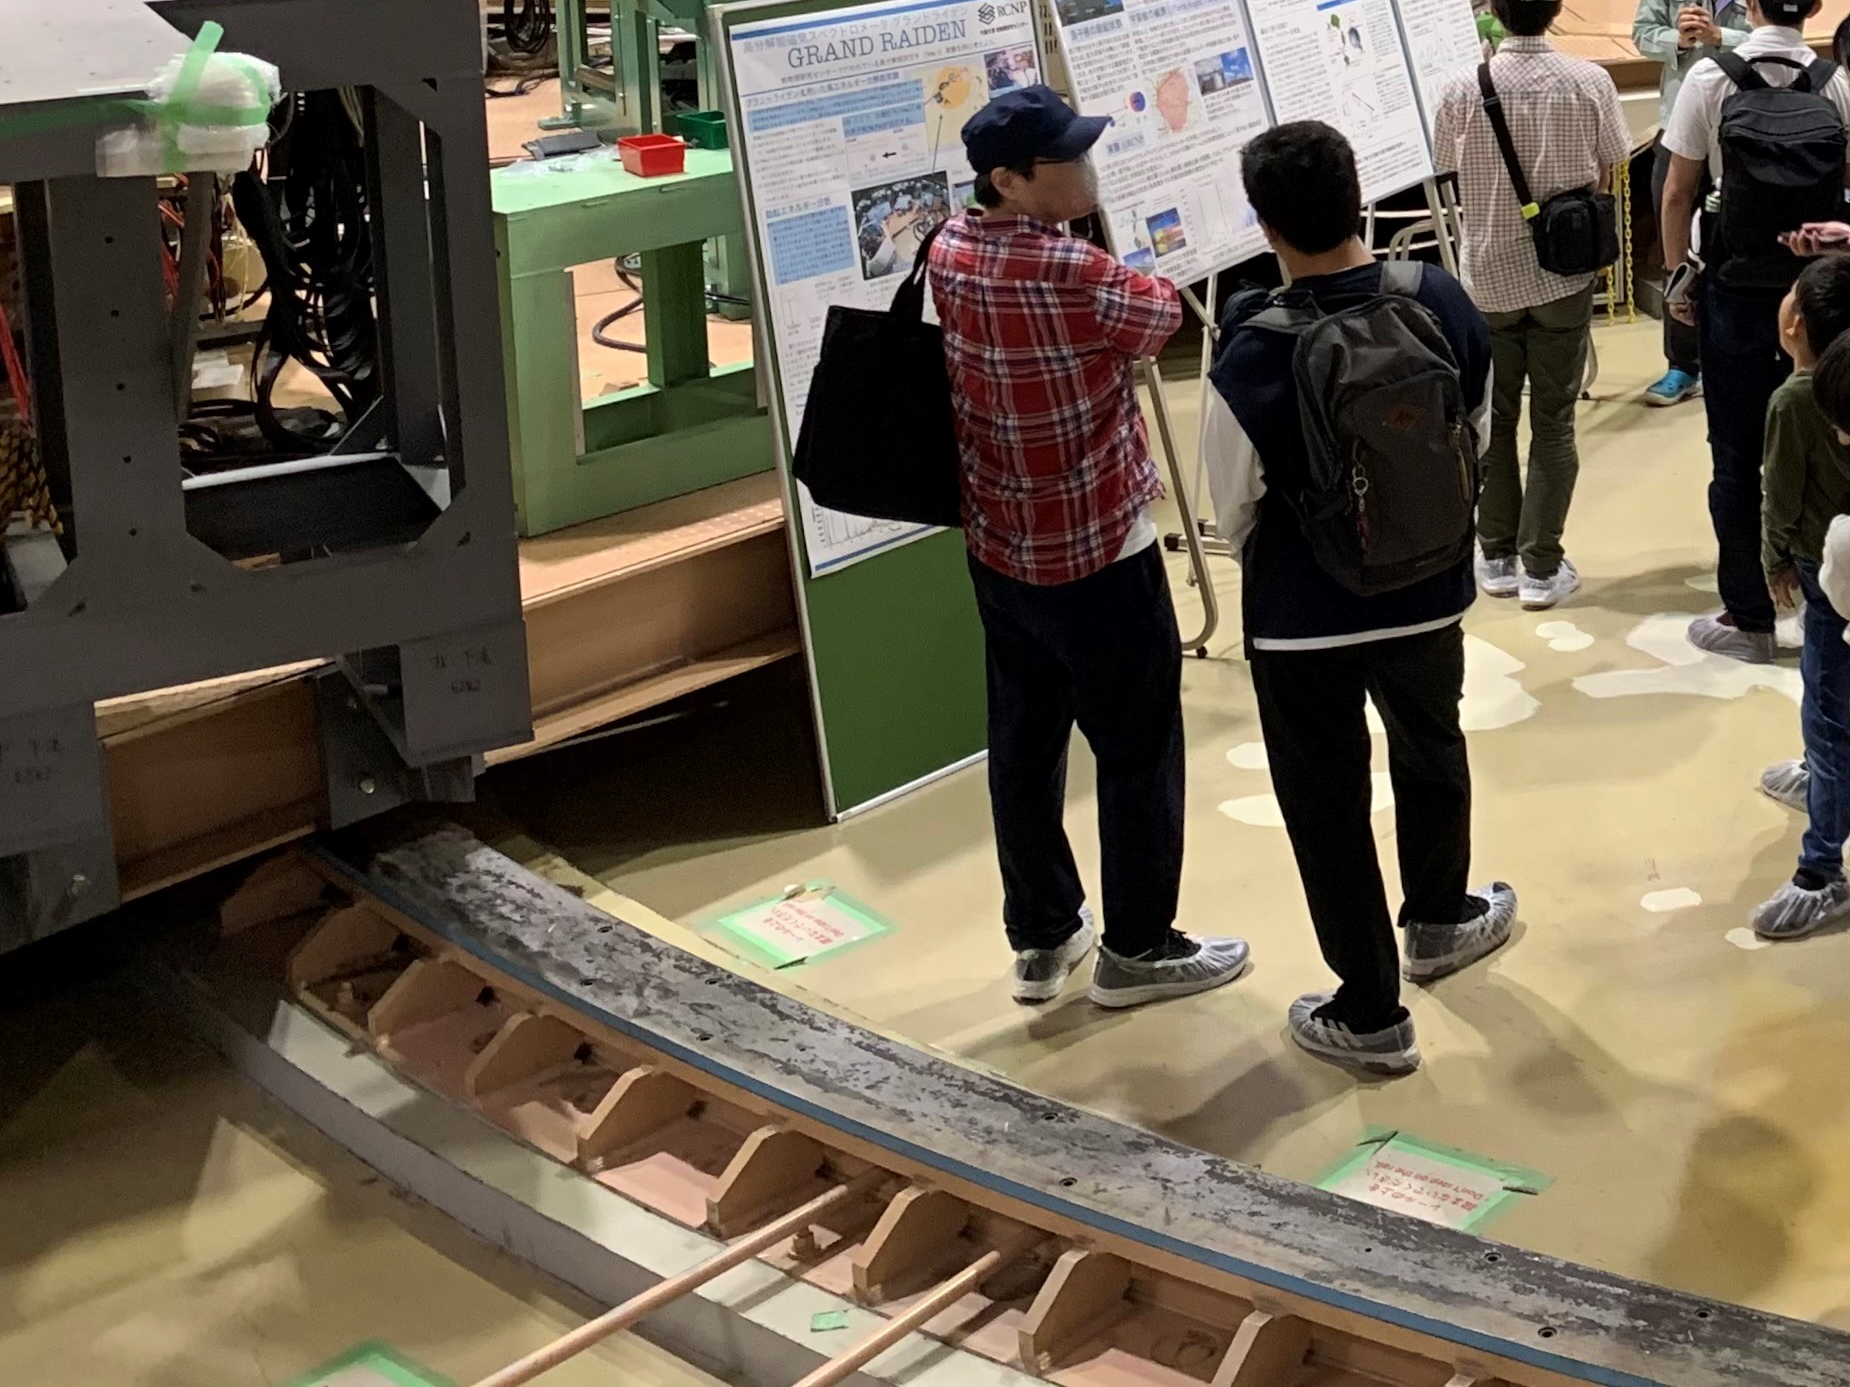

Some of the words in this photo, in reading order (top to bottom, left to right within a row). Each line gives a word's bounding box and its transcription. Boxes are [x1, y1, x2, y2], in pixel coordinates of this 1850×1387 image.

[997, 0, 1028, 19] RCNP
[787, 35, 875, 69] GRAND
[881, 19, 968, 52] RAIDEN
[1453, 1185, 1484, 1201] Don't
